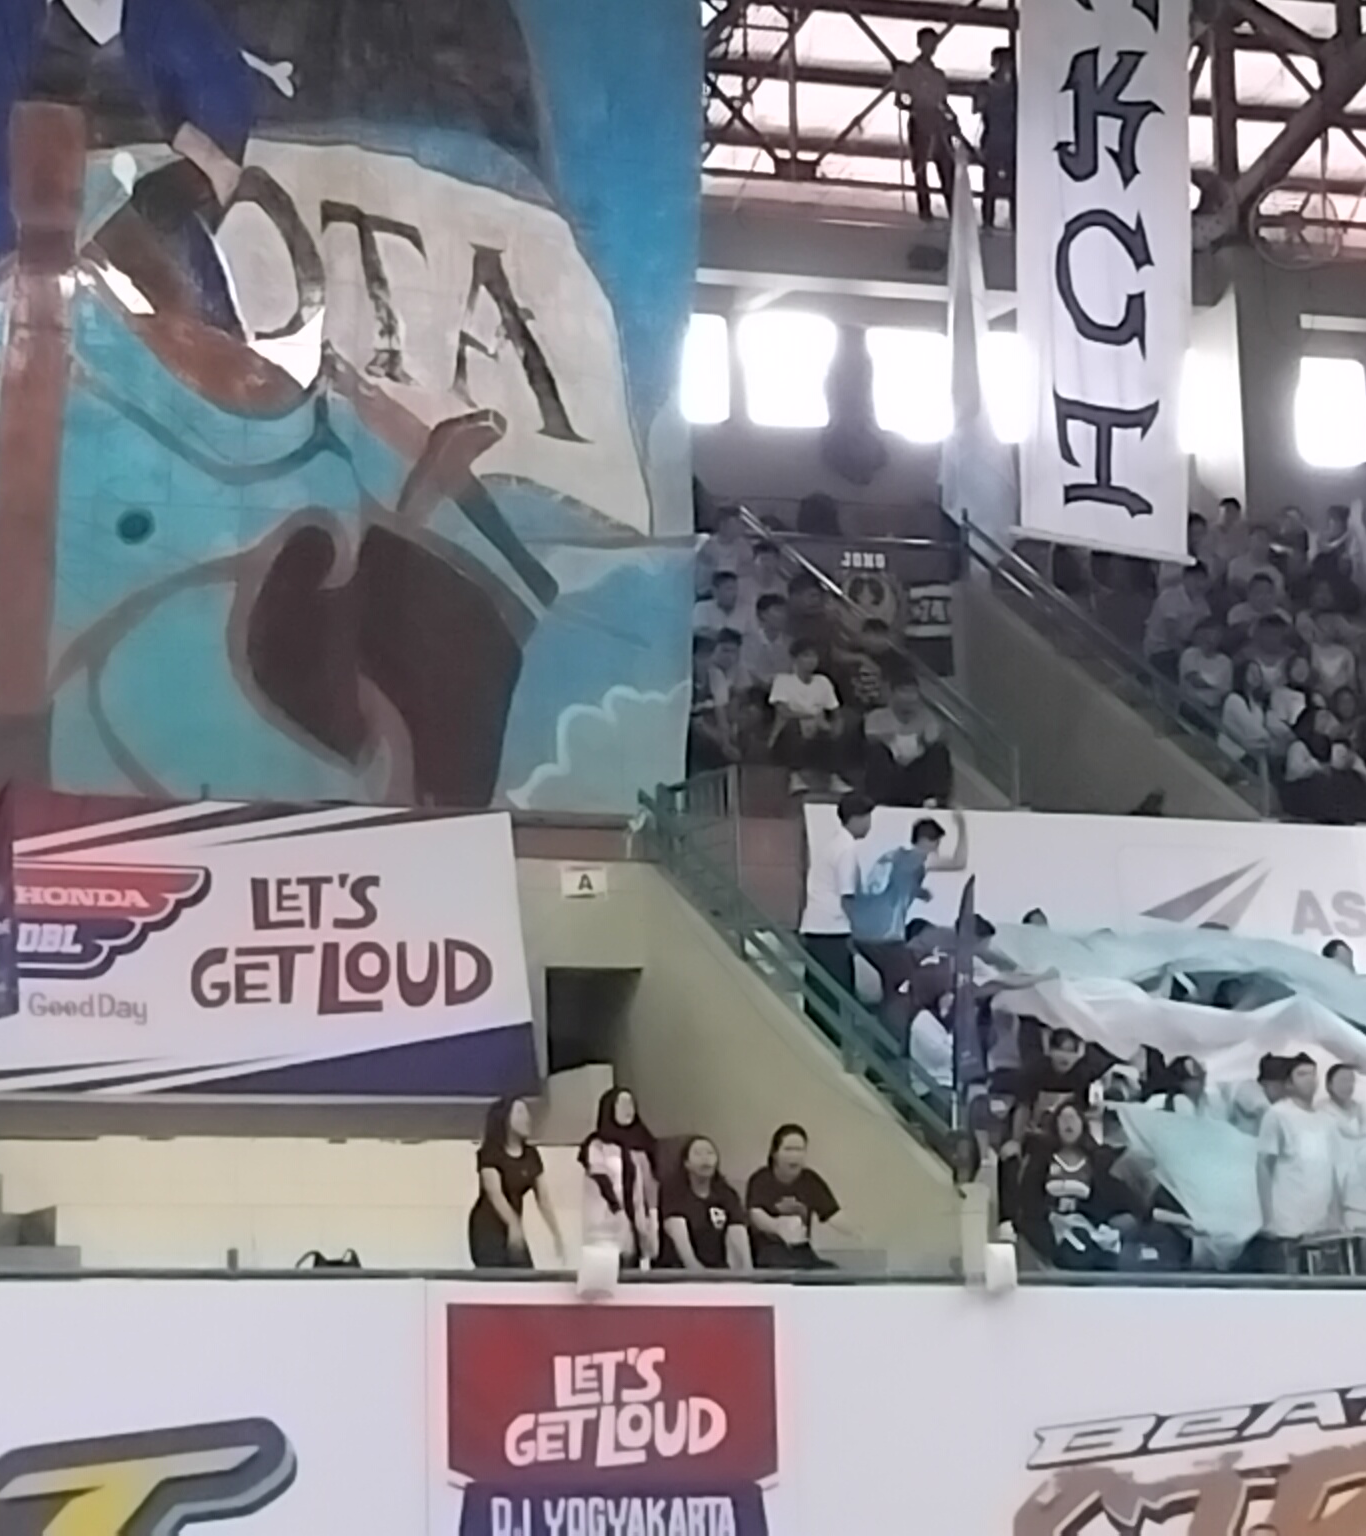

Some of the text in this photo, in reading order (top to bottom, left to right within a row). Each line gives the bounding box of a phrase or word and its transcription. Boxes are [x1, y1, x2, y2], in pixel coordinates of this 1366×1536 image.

[14, 885, 151, 909] HONDA
[250, 873, 380, 931] LET'S
[577, 873, 594, 892] A
[16, 923, 83, 954] DBL
[191, 937, 495, 1016] GET LOUD
[553, 1347, 665, 1408] LET'S
[505, 1396, 727, 1468] GET LOUD
[544, 1496, 736, 1536] YOGYAKARTA
